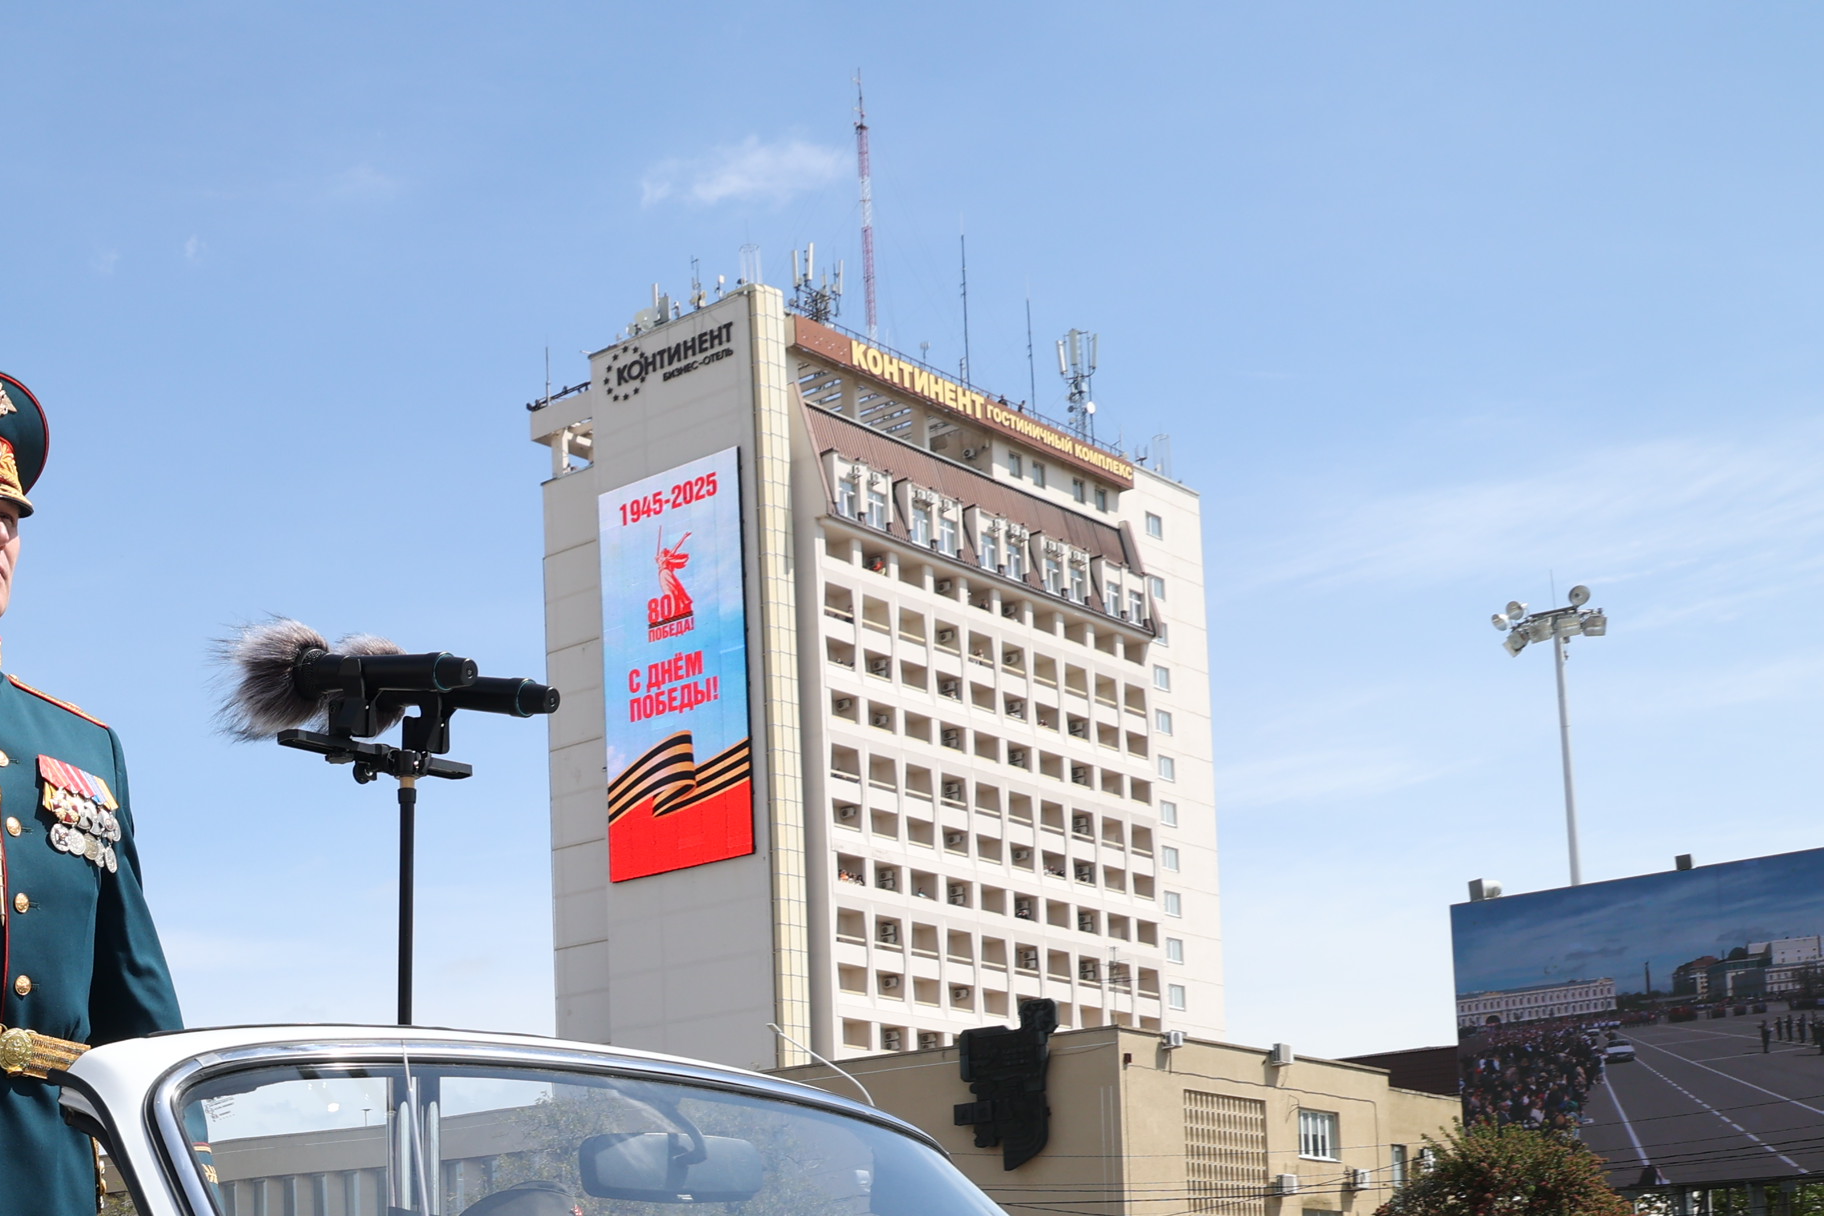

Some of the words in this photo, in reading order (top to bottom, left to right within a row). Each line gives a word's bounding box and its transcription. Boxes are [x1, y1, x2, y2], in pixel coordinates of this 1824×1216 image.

[616, 321, 733, 386] КОНТИНЕНТ
[662, 347, 734, 382] БИЗНЕС-ОТЕЛЬ
[851, 340, 985, 419] КОНТИНЕНТ
[987, 404, 1073, 454] ГОСТИНИЧНЫЙ
[1075, 443, 1133, 480] КОМПЛЕКС
[619, 472, 718, 526] 1945-2025
[648, 595, 672, 623] 80
[648, 617, 694, 643] ПОБЕДА!
[628, 668, 641, 693] С
[646, 650, 703, 693] ДНЁМ
[629, 676, 720, 722] ПОБЕДЫ!
